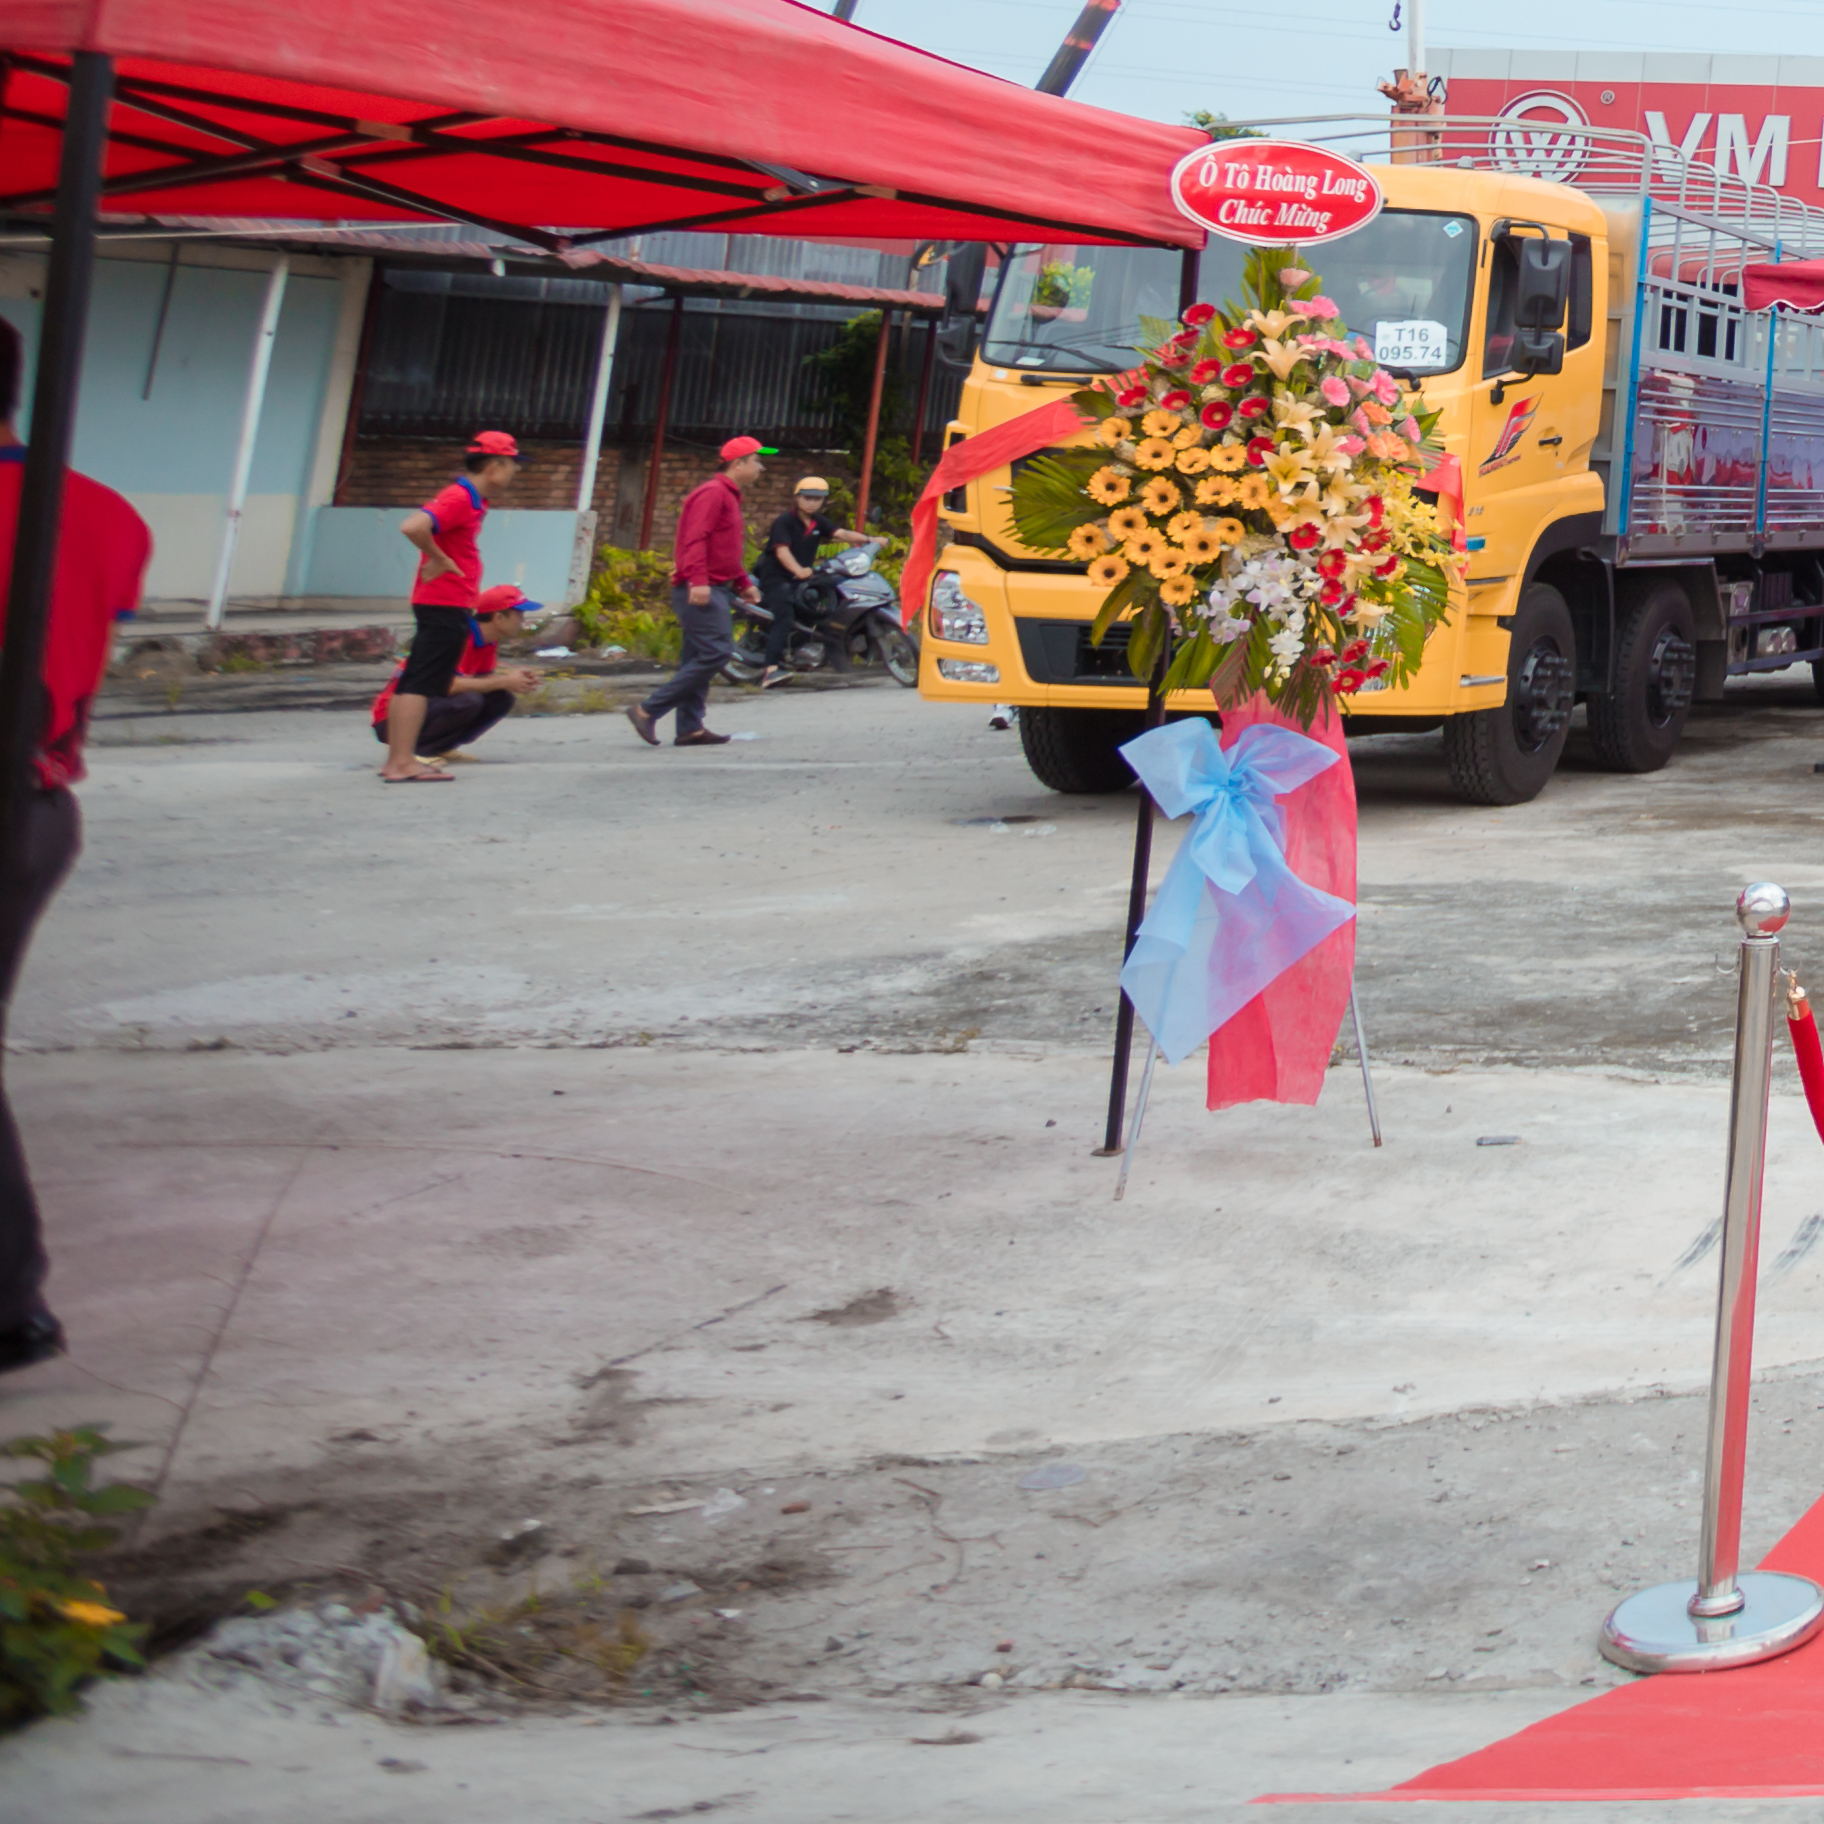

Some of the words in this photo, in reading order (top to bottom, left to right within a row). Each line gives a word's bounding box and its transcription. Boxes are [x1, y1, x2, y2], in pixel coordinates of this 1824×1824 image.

[1200, 154, 1218, 187] Ô
[1225, 163, 1249, 189] Tô
[1255, 166, 1318, 200] Hoàng
[1322, 170, 1368, 203] Long
[1219, 199, 1271, 226] Chúc
[1274, 203, 1332, 234] Mừng
[1394, 328, 1429, 342] T16
[1379, 346, 1442, 360] 095.74
